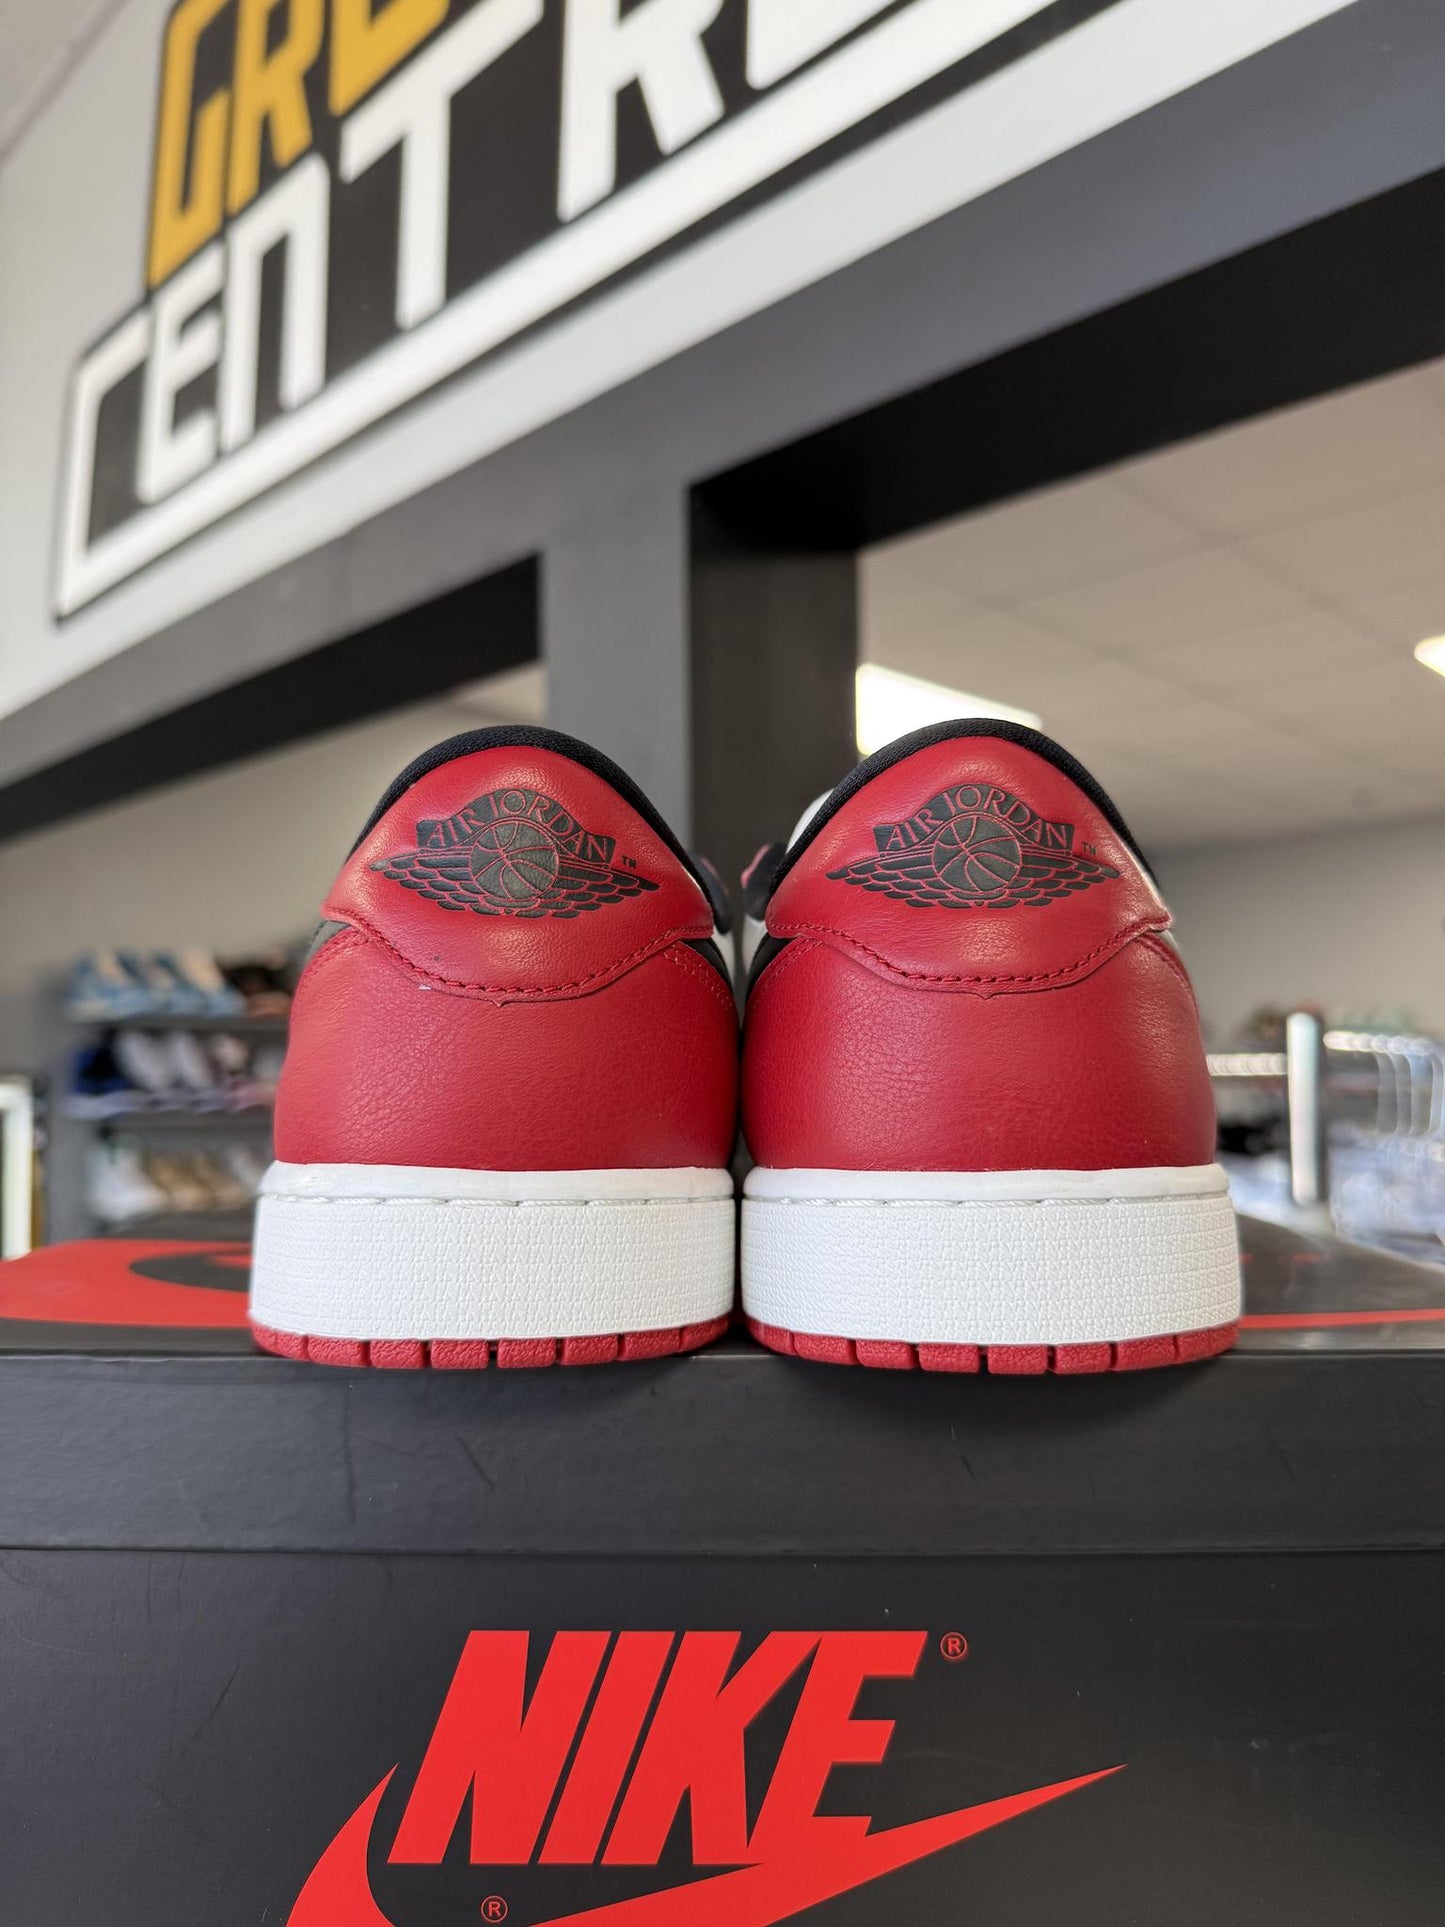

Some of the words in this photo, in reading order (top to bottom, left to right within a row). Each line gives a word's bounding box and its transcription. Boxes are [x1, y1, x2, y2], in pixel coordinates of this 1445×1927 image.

[54, 0, 898, 617] CENTR
[428, 808, 484, 848] AIR
[488, 790, 607, 861] JORDAN
[885, 808, 945, 850] AIR
[943, 785, 1068, 849] JORDAN
[386, 1630, 928, 1865] NIKE
